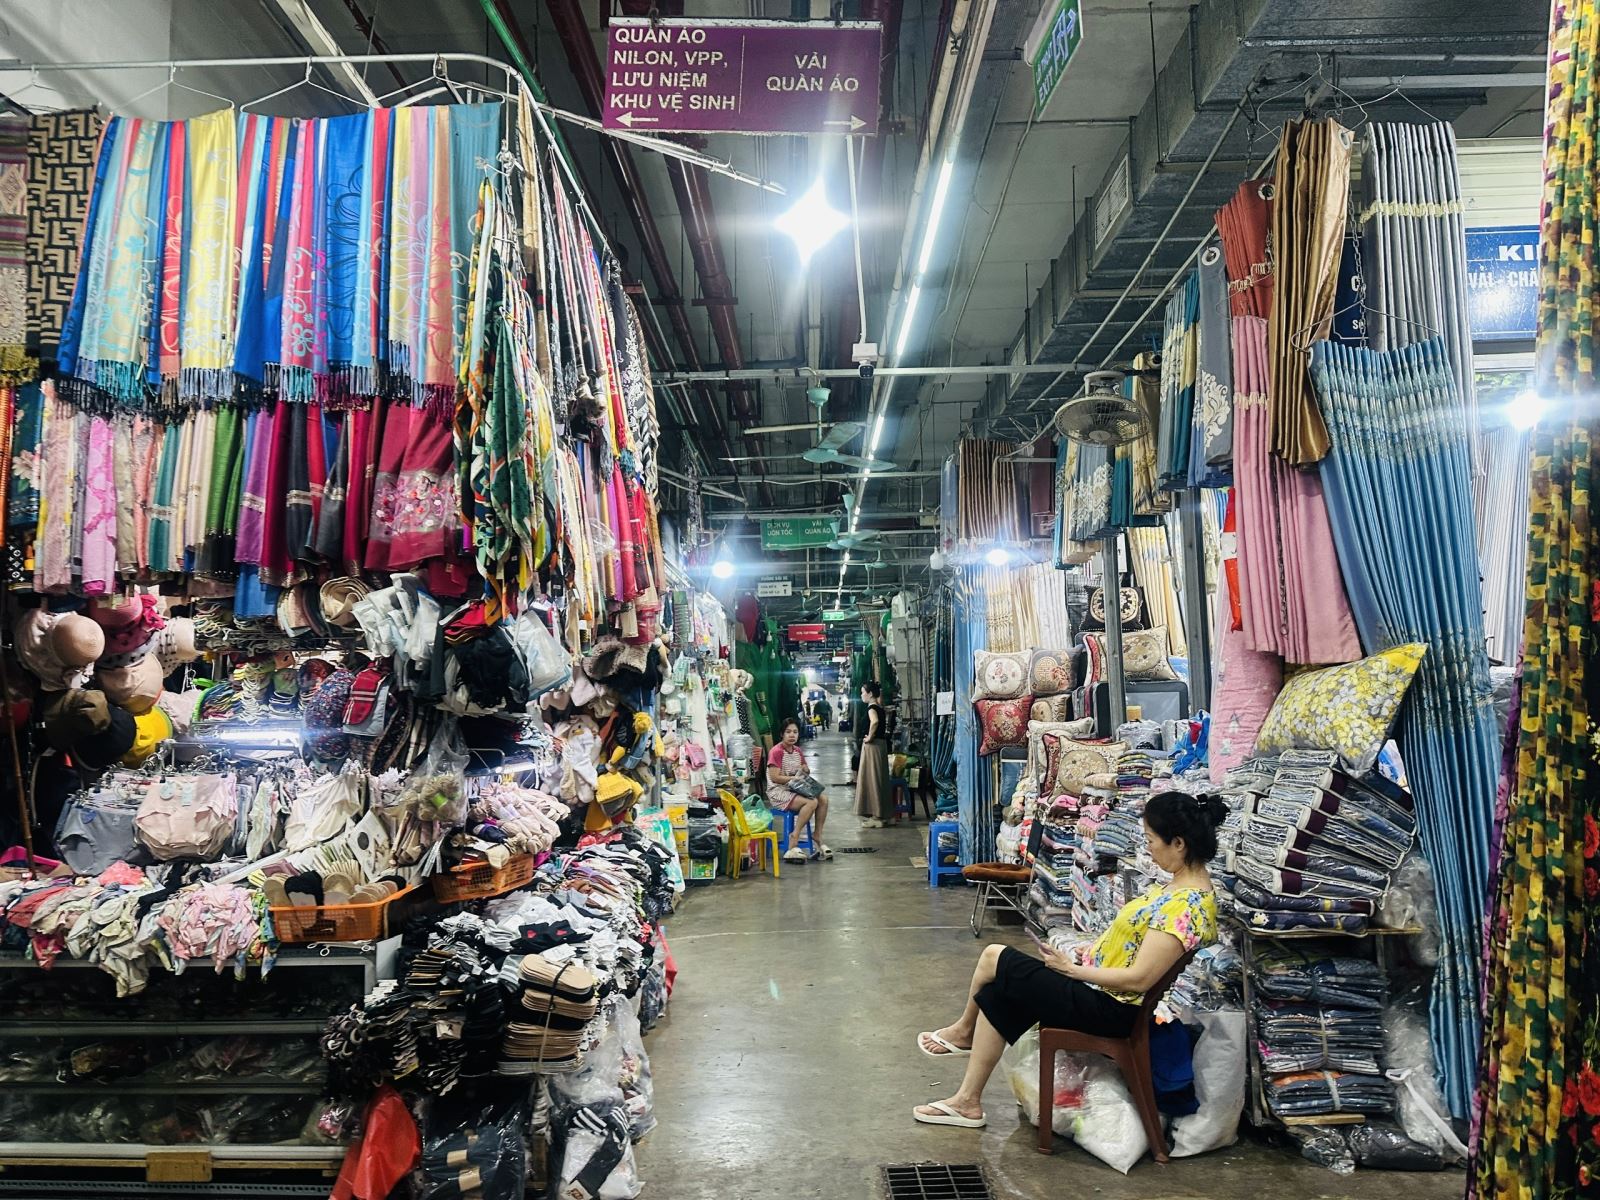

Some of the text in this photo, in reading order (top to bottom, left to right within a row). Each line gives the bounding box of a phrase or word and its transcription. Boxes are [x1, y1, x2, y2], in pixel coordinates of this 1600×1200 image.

[613, 50, 728, 68] NILON, VPP,
[794, 51, 827, 70] VẢI
[612, 70, 708, 90] LƯU NIỆM
[829, 73, 859, 92] ÁO
[1038, 66, 1053, 107] EXIT
[610, 92, 736, 112] KHU VỆ SINH
[1498, 244, 1540, 261] KI
